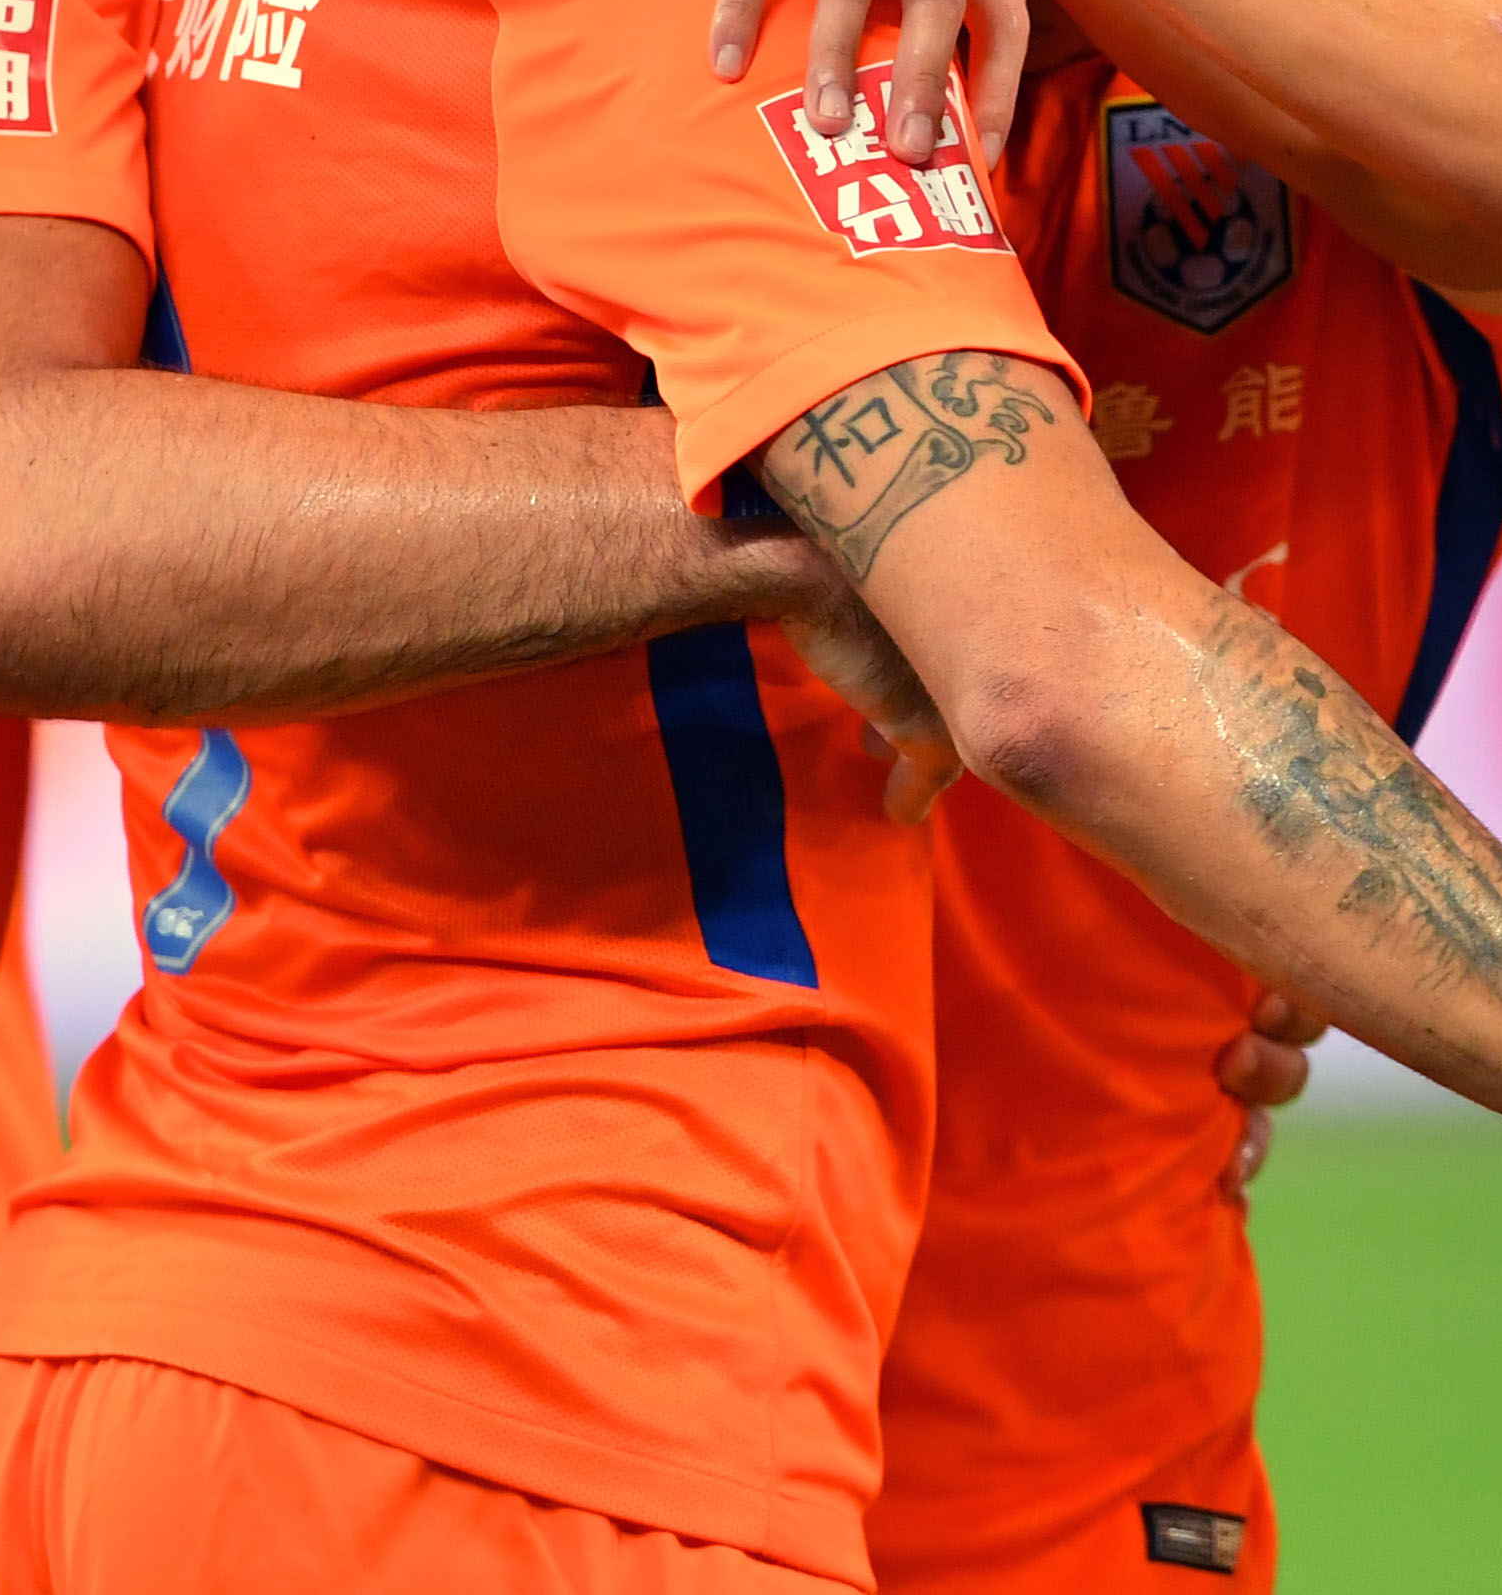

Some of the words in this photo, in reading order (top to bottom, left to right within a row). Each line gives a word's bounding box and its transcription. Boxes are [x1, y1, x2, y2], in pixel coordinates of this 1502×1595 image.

[791, 79, 961, 177] 捷
[837, 163, 995, 244] 分期
[793, 394, 904, 489] 和
[1091, 362, 1305, 461] 鲁能
